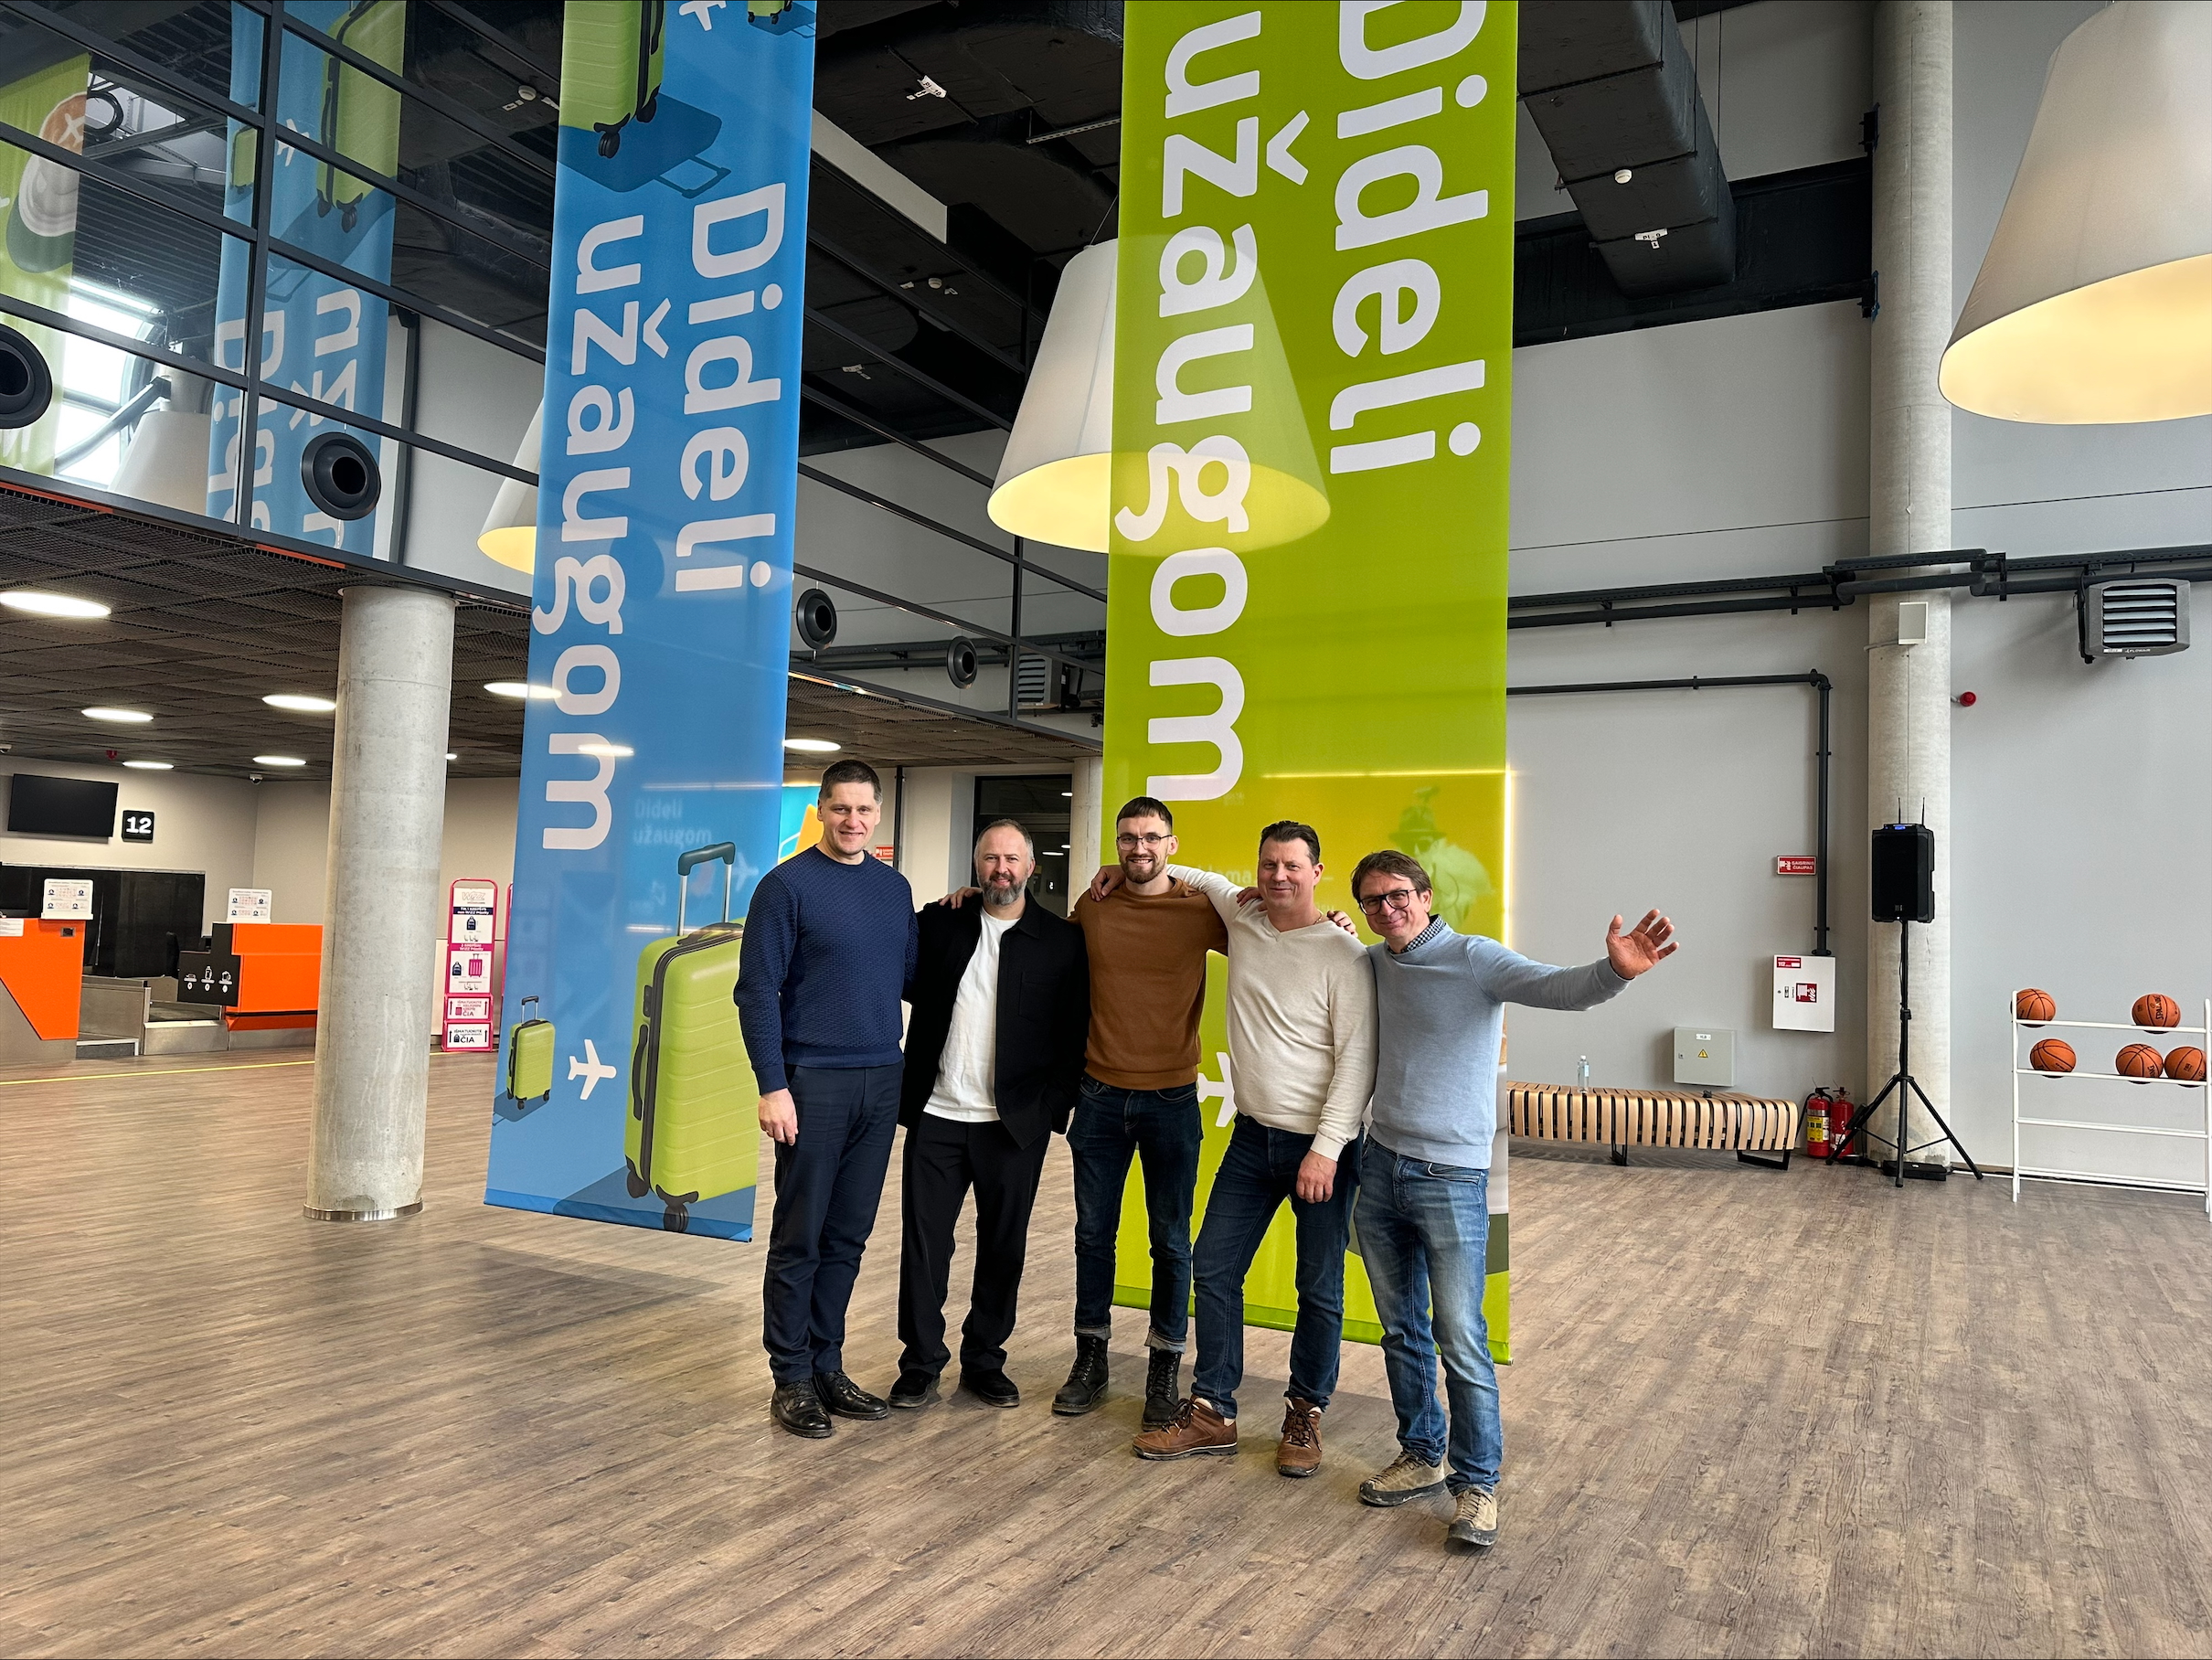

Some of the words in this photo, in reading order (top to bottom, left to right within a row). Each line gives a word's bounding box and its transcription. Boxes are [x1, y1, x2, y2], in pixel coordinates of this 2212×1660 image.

[675, 183, 786, 592] Dideli
[1114, 10, 1310, 803] užaugom
[1329, 0, 1489, 474] Dideli
[532, 215, 672, 850] užaugom
[126, 816, 152, 834] 12
[460, 1035, 475, 1043] ČIA
